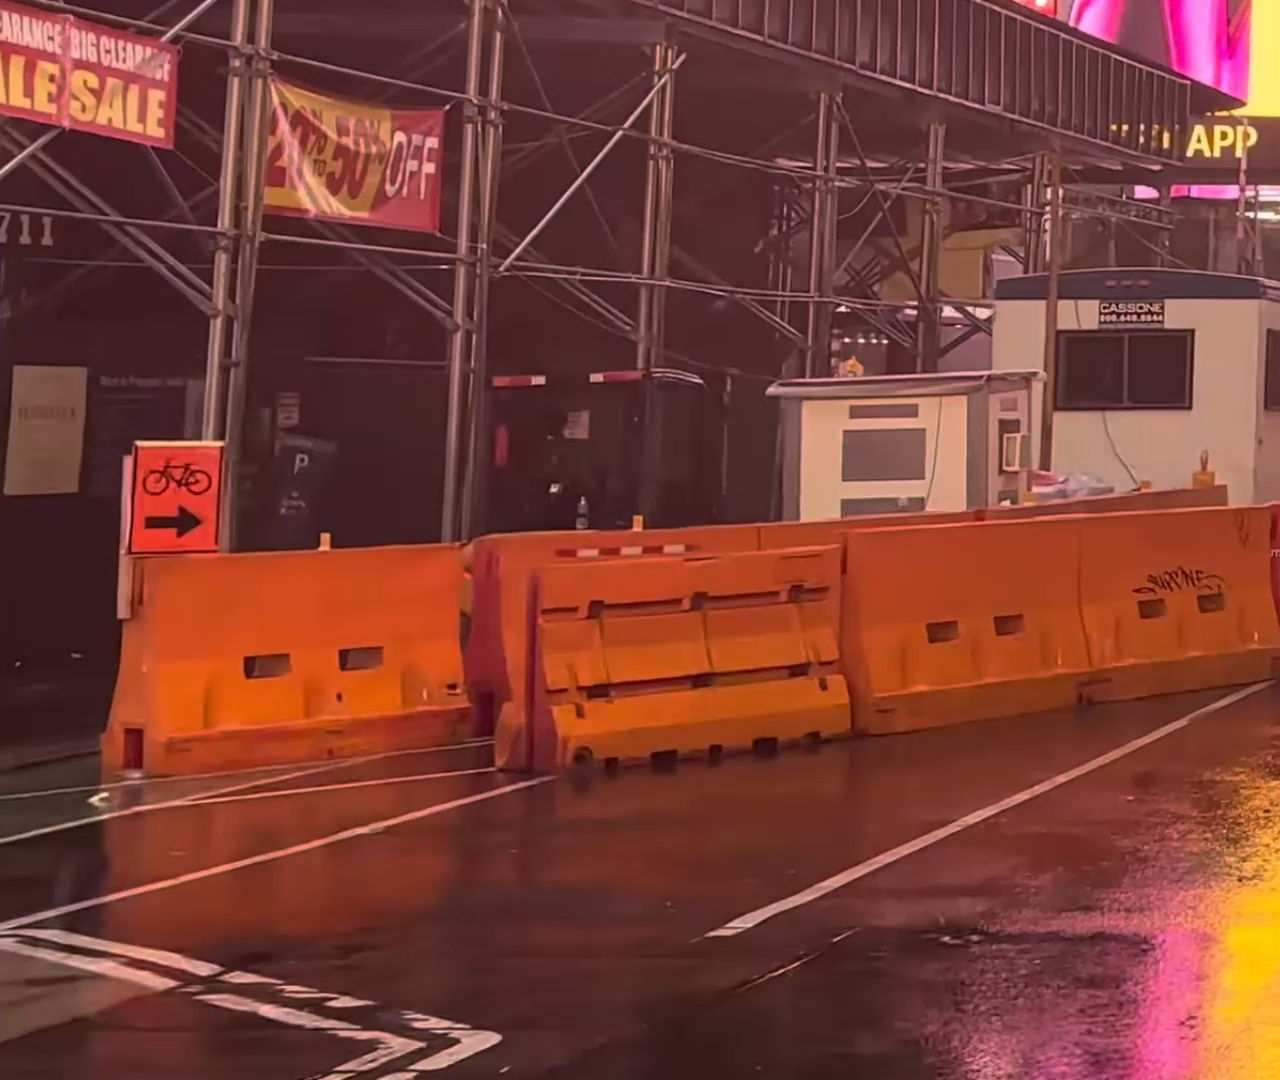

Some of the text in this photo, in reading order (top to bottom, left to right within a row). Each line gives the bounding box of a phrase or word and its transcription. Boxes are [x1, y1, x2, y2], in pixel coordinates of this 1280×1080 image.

[0, 10, 62, 56] ARANCE
[70, 26, 171, 82] BIG CLEARANCE
[69, 69, 167, 139] SALE
[384, 129, 440, 201] OFF
[1185, 123, 1259, 159] APP
[1100, 303, 1163, 313] CASSONE
